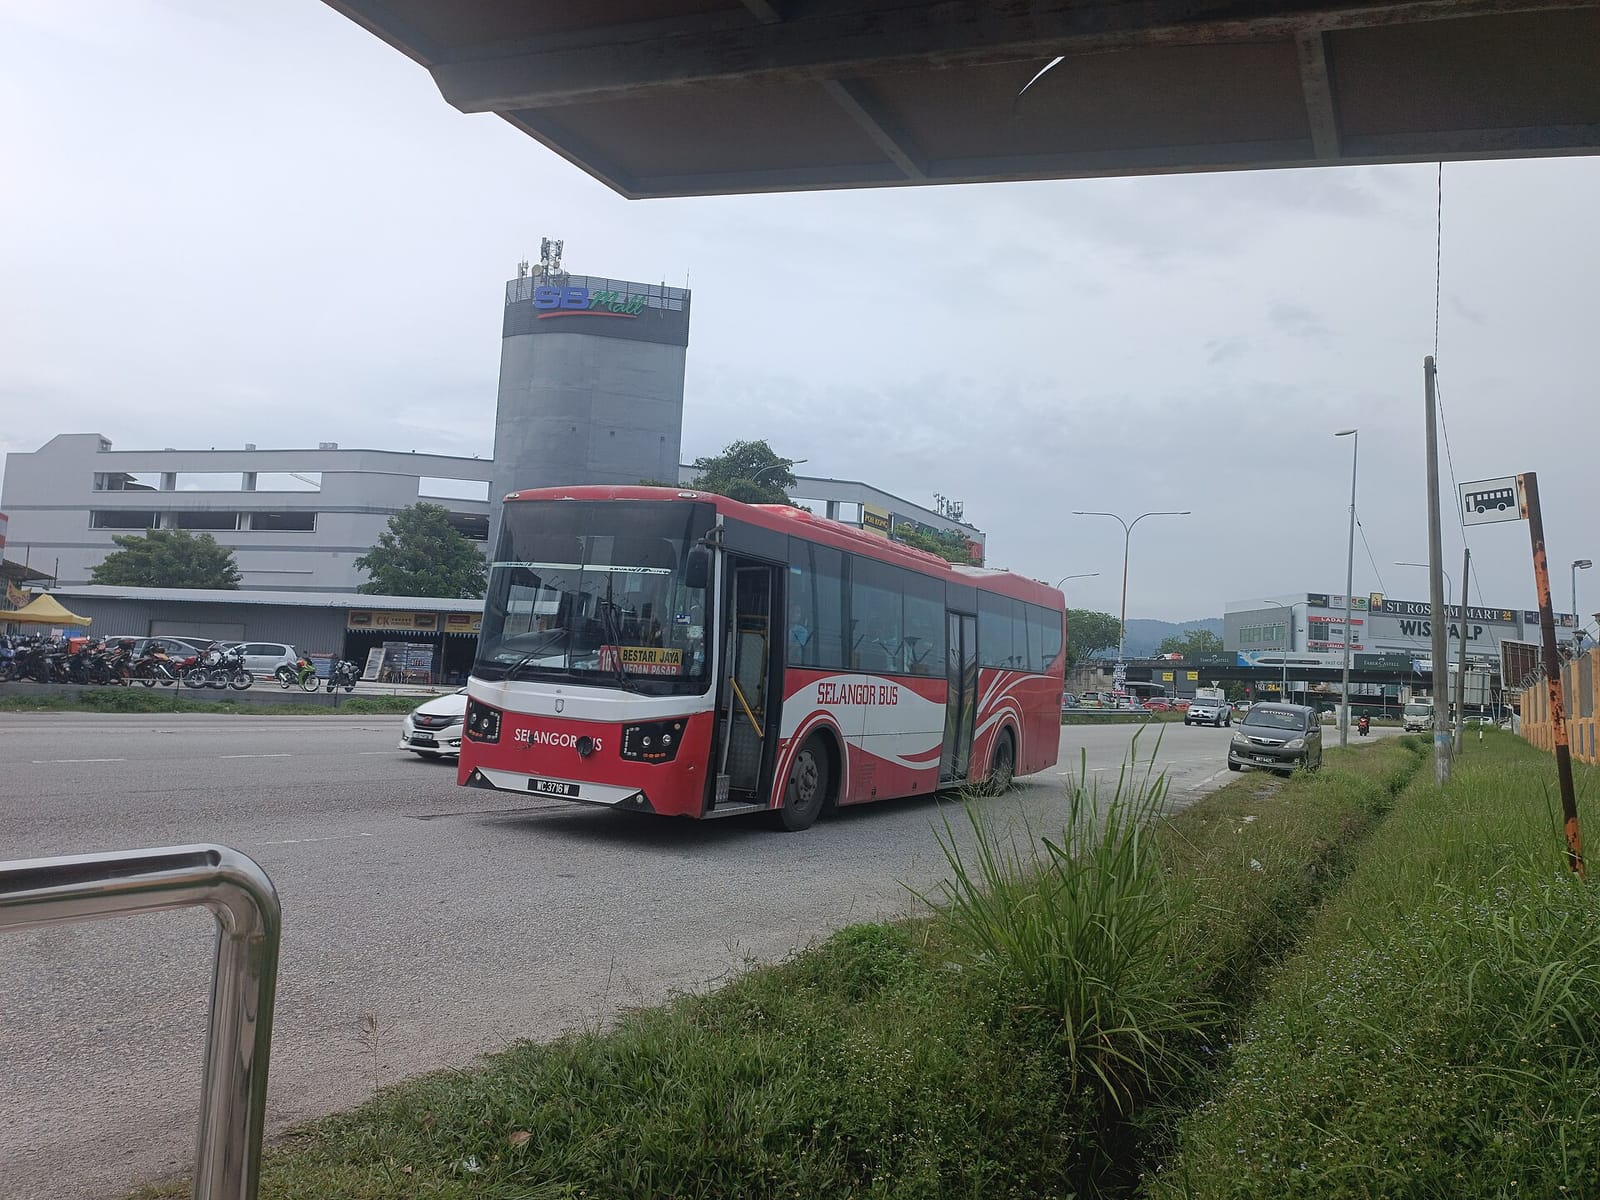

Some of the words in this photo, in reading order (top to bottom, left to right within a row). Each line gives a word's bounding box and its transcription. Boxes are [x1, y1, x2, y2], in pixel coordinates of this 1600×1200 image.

[533, 286, 589, 309] SB
[588, 290, 645, 315] Mall
[1386, 602, 1402, 613] ST
[1407, 604, 1459, 618] ROSM
[1466, 607, 1499, 620] MART
[1401, 619, 1461, 640] WISA
[623, 649, 657, 662] BESTARI
[660, 651, 679, 664] JAYA
[651, 665, 676, 676] PASAR
[817, 682, 876, 705] SELANGOR
[879, 684, 898, 706] BUS
